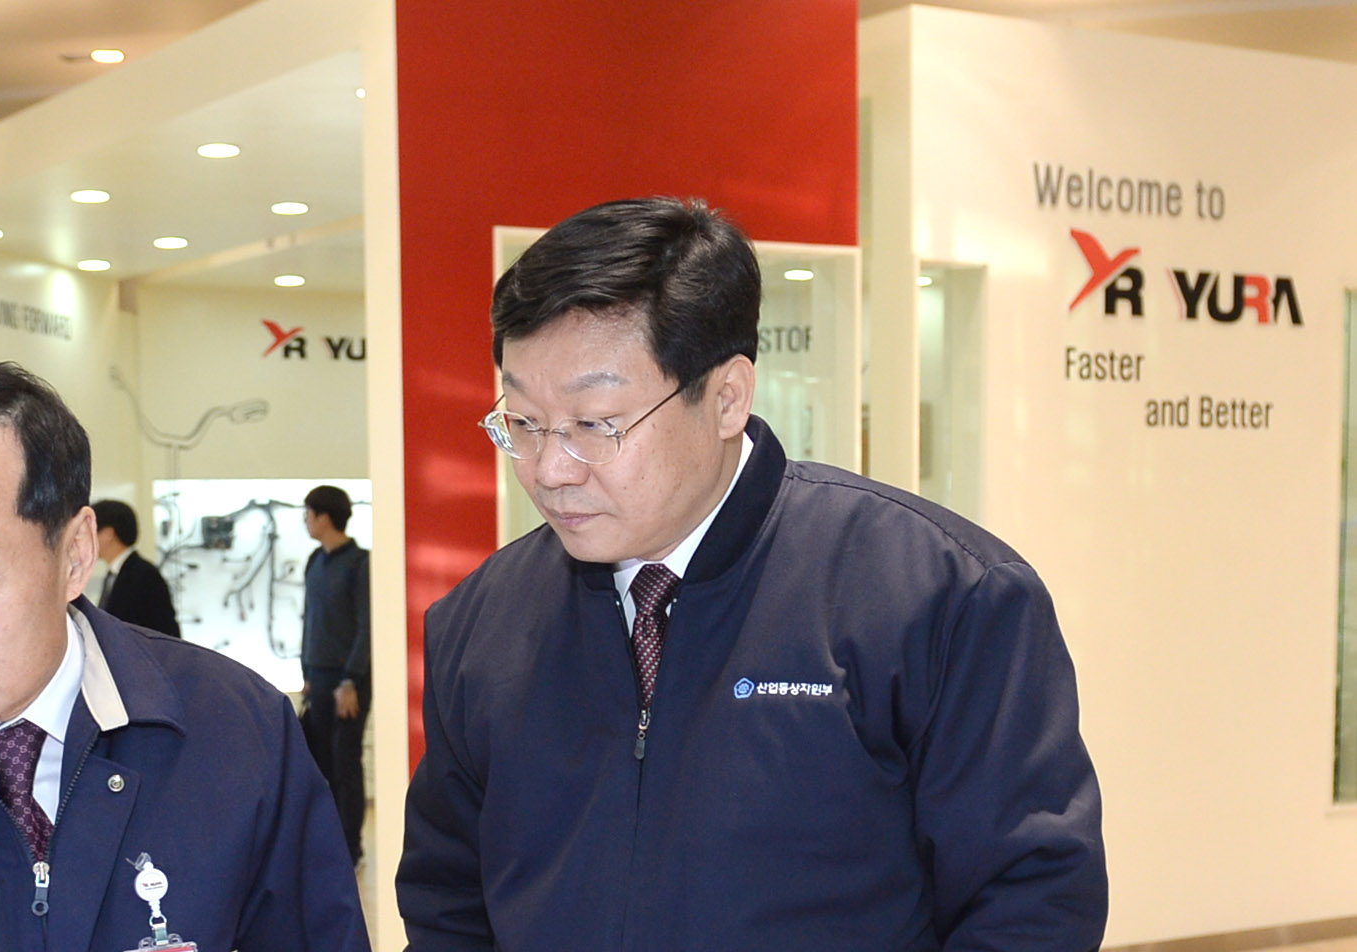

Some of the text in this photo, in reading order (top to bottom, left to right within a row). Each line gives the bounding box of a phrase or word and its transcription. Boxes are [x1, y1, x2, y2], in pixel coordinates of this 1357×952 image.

[1033, 163, 1226, 221] Welcome to
[1166, 268, 1303, 326] YURA
[322, 336, 366, 361] YU
[1065, 347, 1145, 382] Faster
[1145, 396, 1273, 429] and Better
[756, 682, 833, 696] 산업통상자원부
